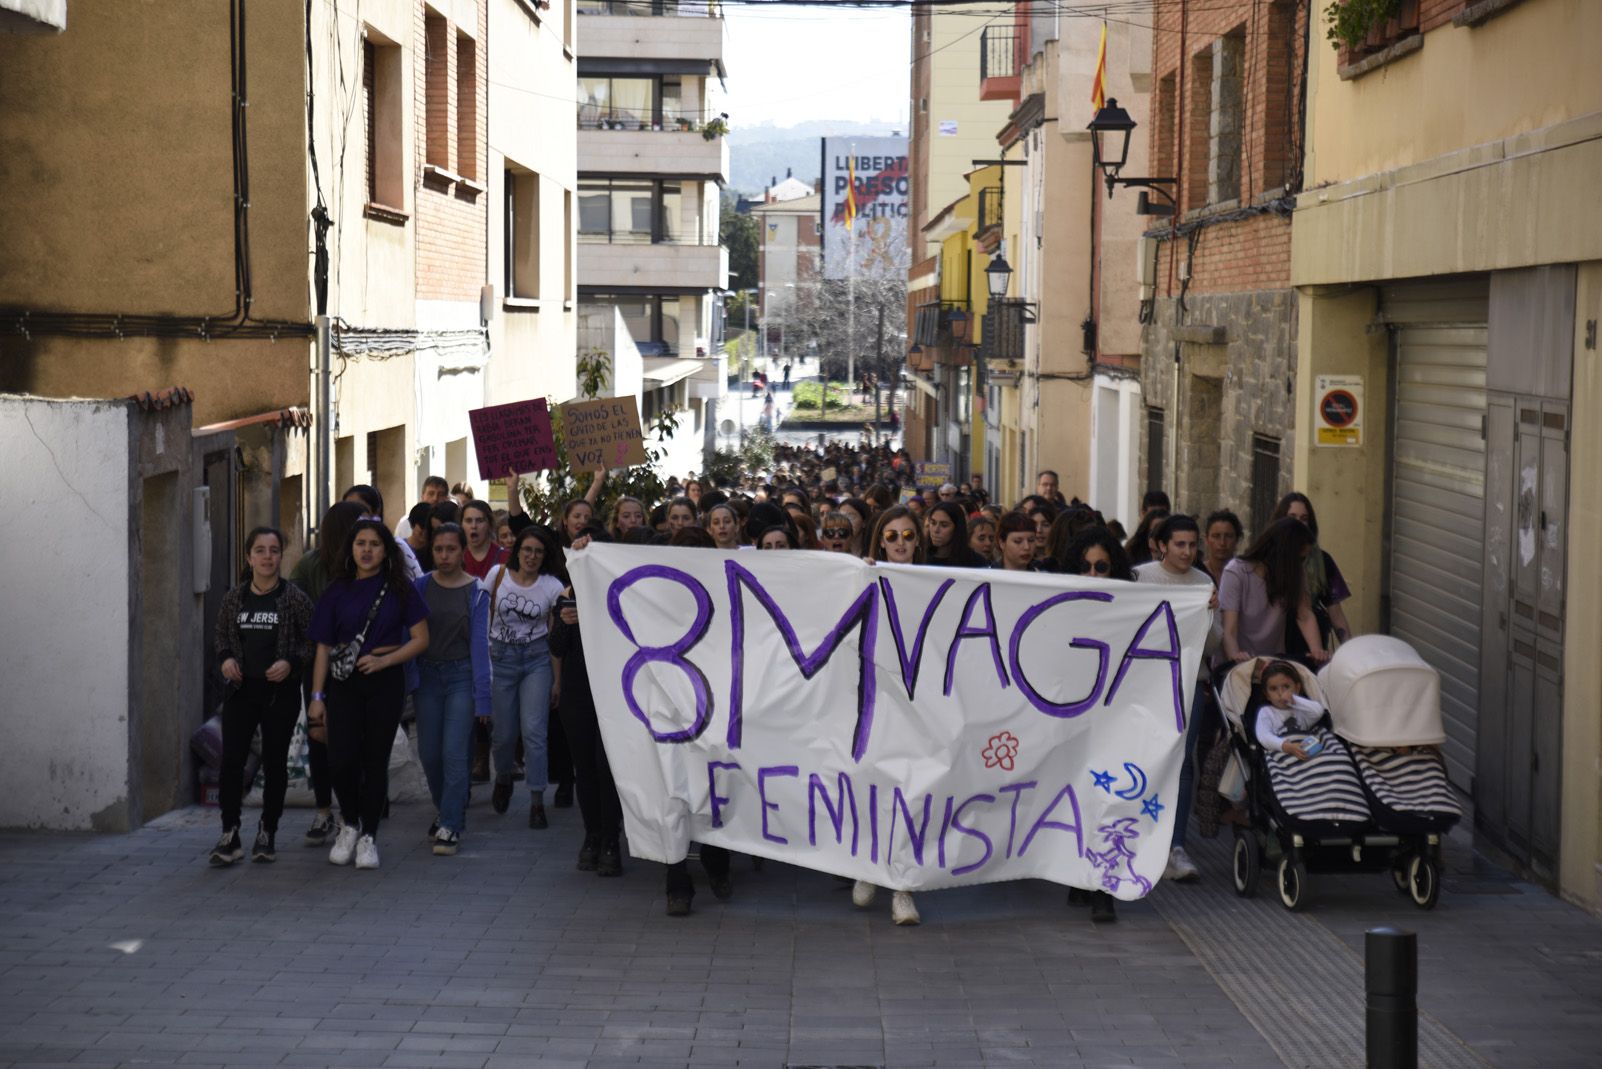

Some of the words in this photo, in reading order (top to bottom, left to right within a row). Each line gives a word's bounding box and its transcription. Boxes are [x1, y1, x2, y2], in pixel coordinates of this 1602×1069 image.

[835, 155, 908, 171] LLIBERT
[612, 404, 626, 416] EL
[597, 423, 607, 431] DE
[611, 417, 629, 429] LAS
[576, 448, 603, 466] VOZ
[879, 576, 1186, 733] VAGA
[707, 761, 1087, 876] FEMINISTA
